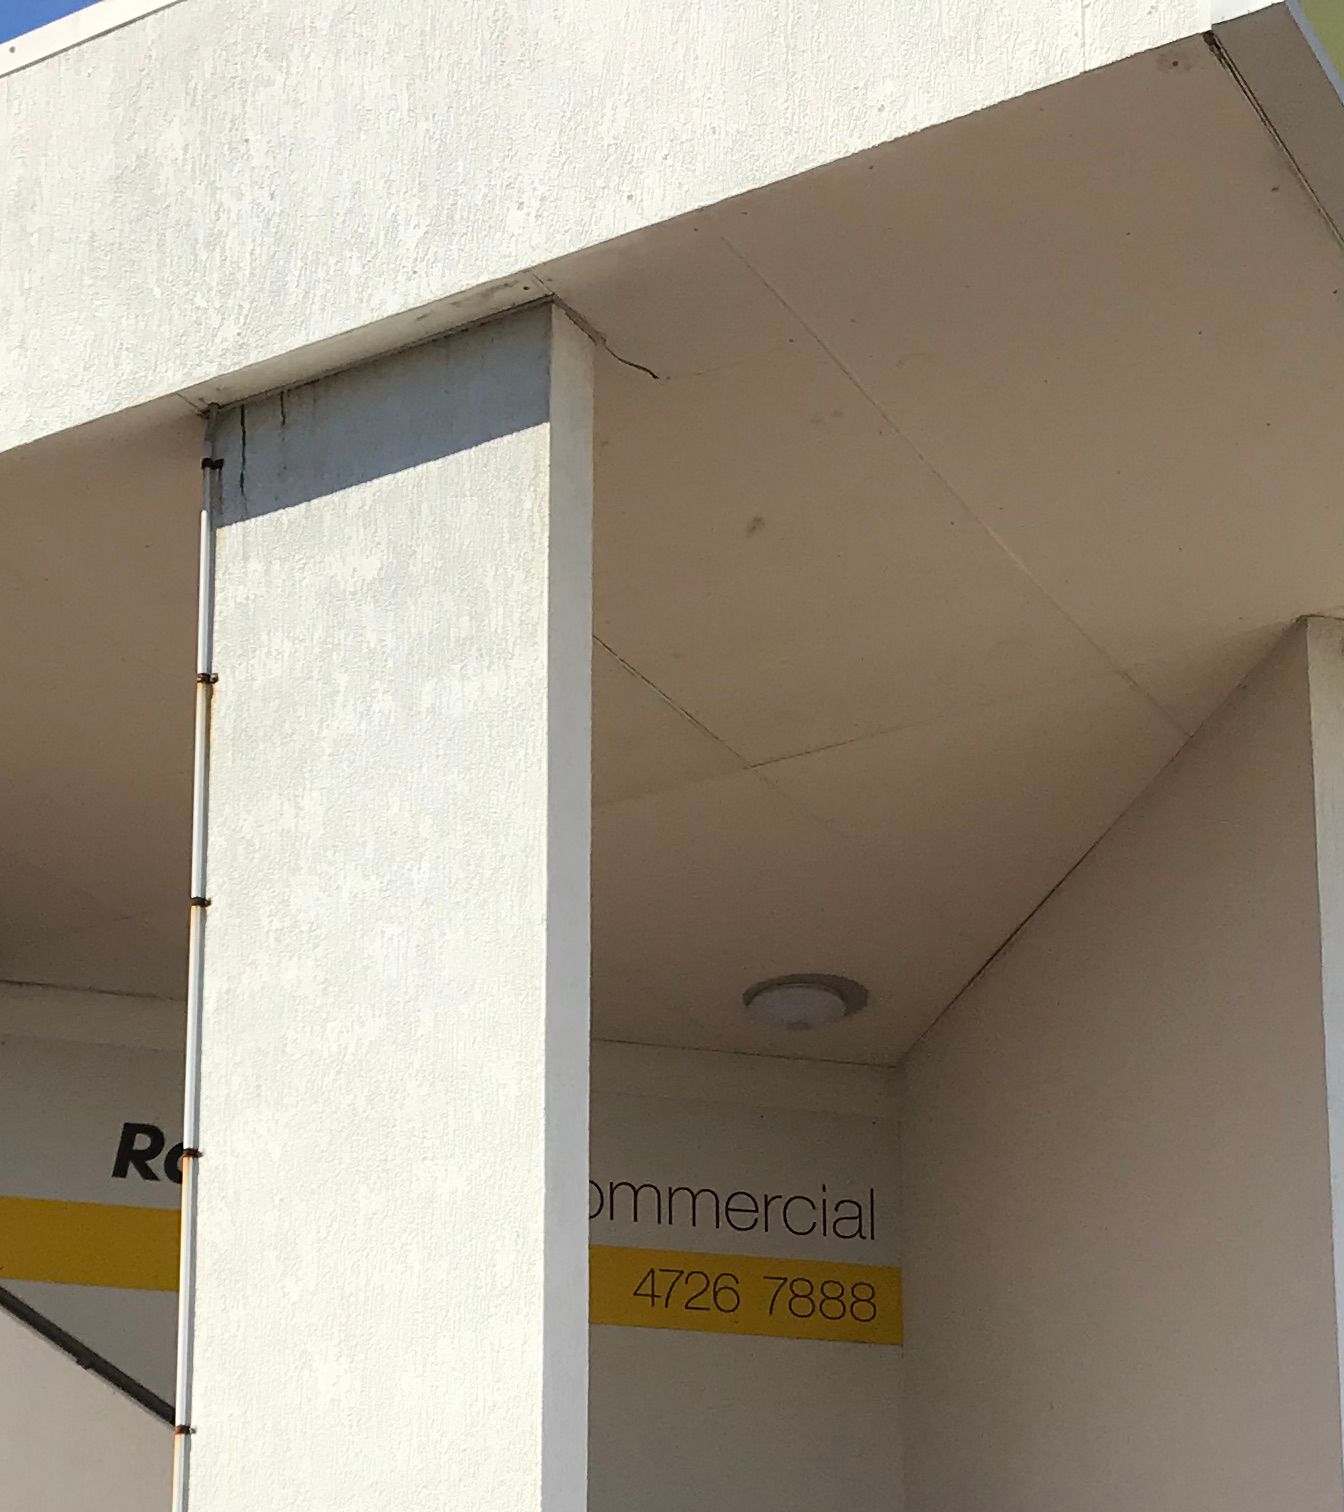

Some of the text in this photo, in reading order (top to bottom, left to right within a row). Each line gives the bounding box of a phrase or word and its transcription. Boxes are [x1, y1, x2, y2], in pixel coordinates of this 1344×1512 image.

[589, 1180, 875, 1240] mmercial
[633, 1268, 877, 1322] 4726 7888
